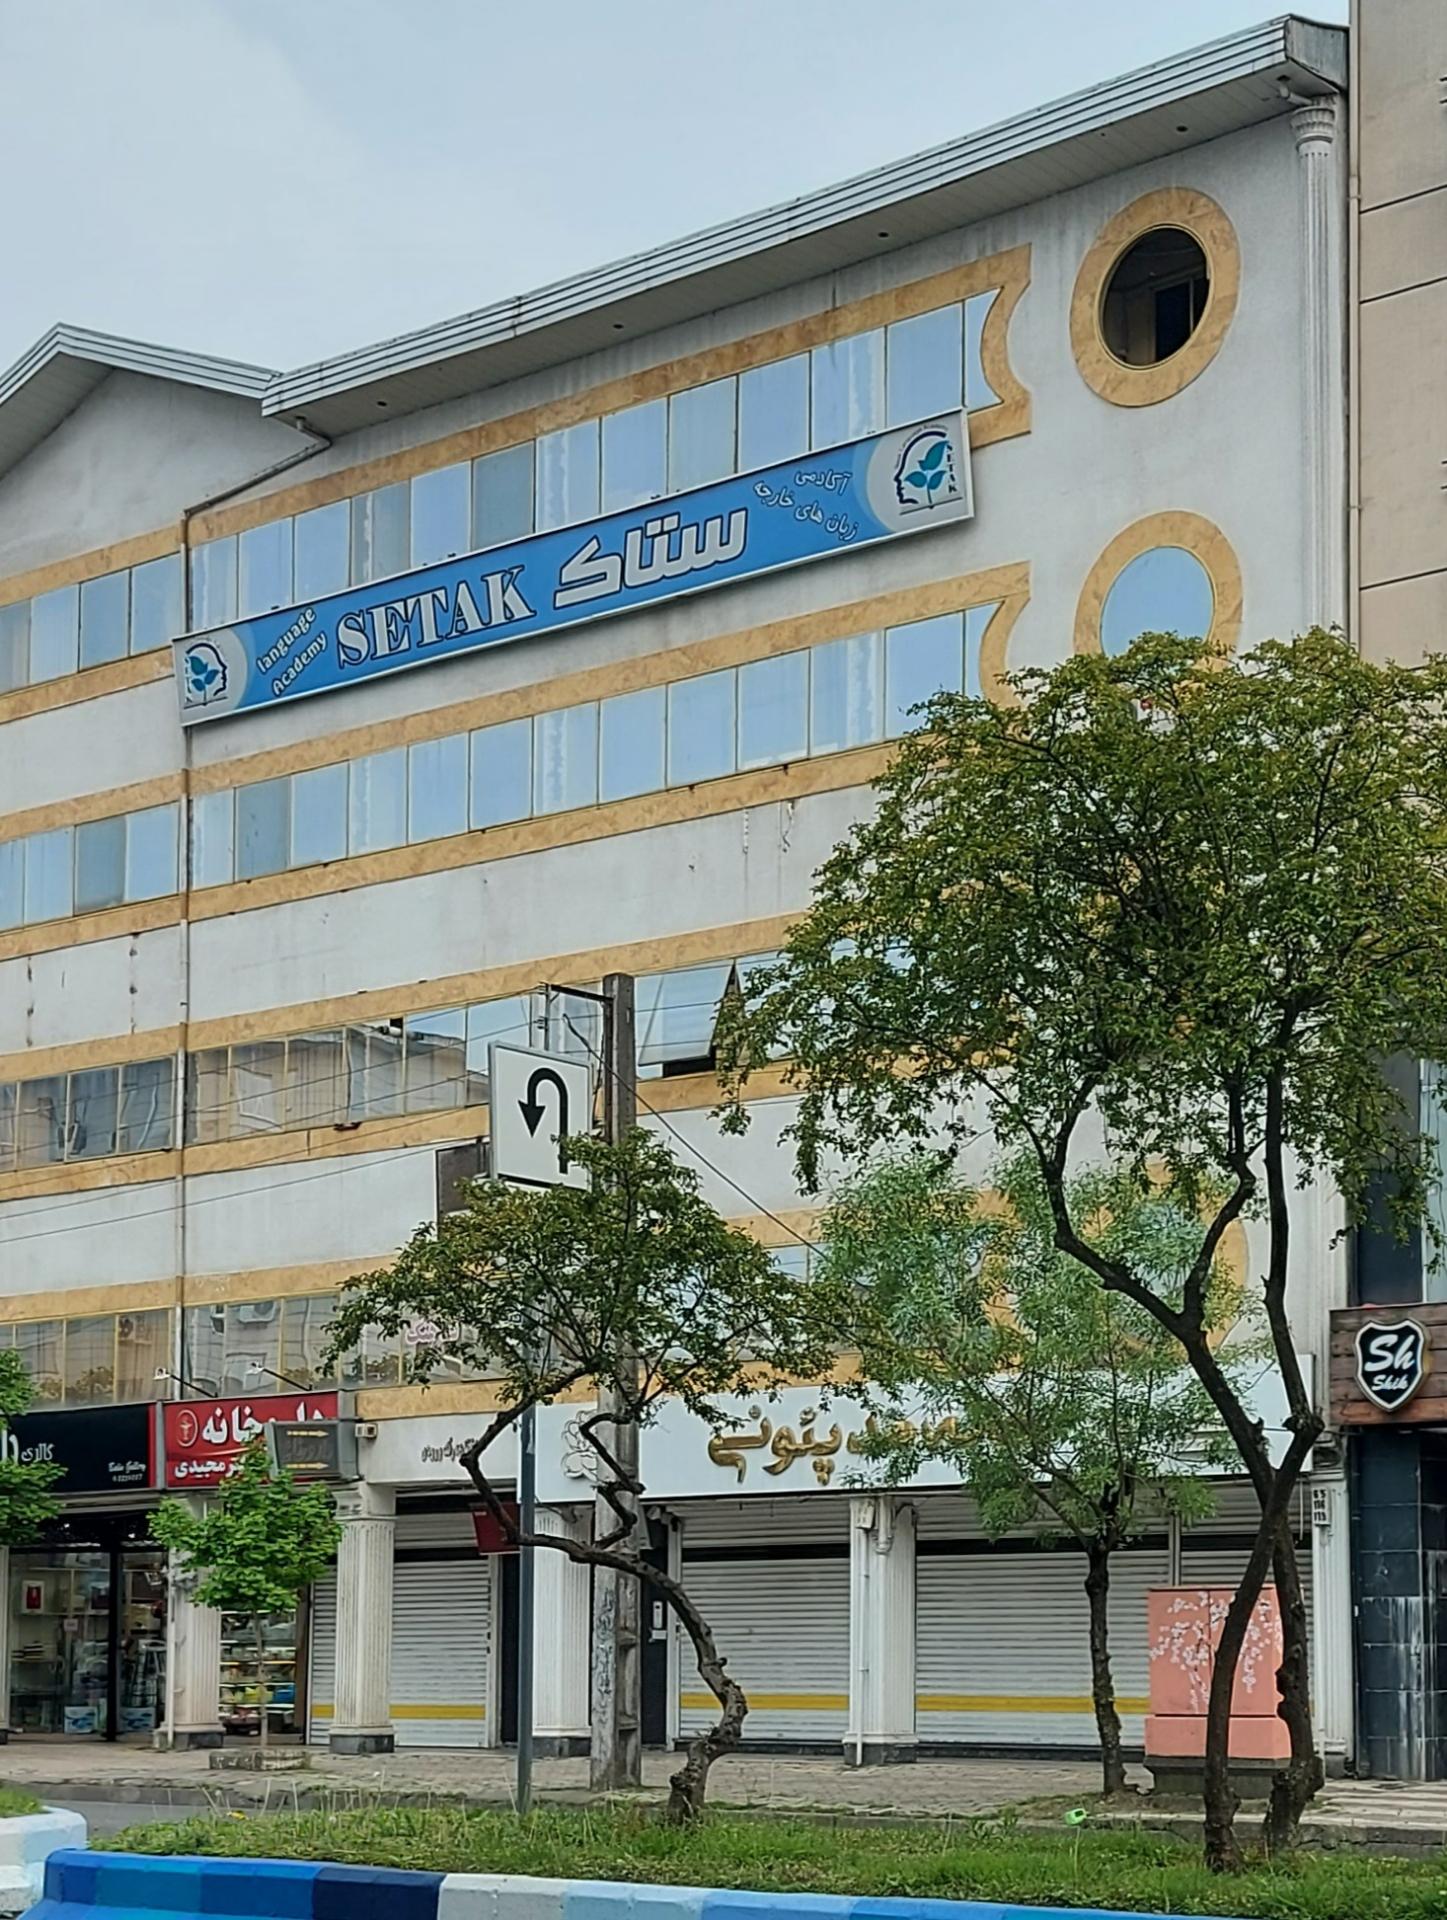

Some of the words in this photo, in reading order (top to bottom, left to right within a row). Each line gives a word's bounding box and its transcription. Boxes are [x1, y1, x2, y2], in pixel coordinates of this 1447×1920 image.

[754, 481, 794, 507] خارجه
[795, 469, 852, 495] آکادمی
[795, 500, 824, 524] های
[825, 513, 859, 540] زبان
[336, 565, 537, 669] SETAK
[256, 607, 316, 675] language
[272, 631, 327, 696] Academy
[1364, 1334, 1415, 1372] Sh
[174, 1459, 226, 1479] مجیدی
